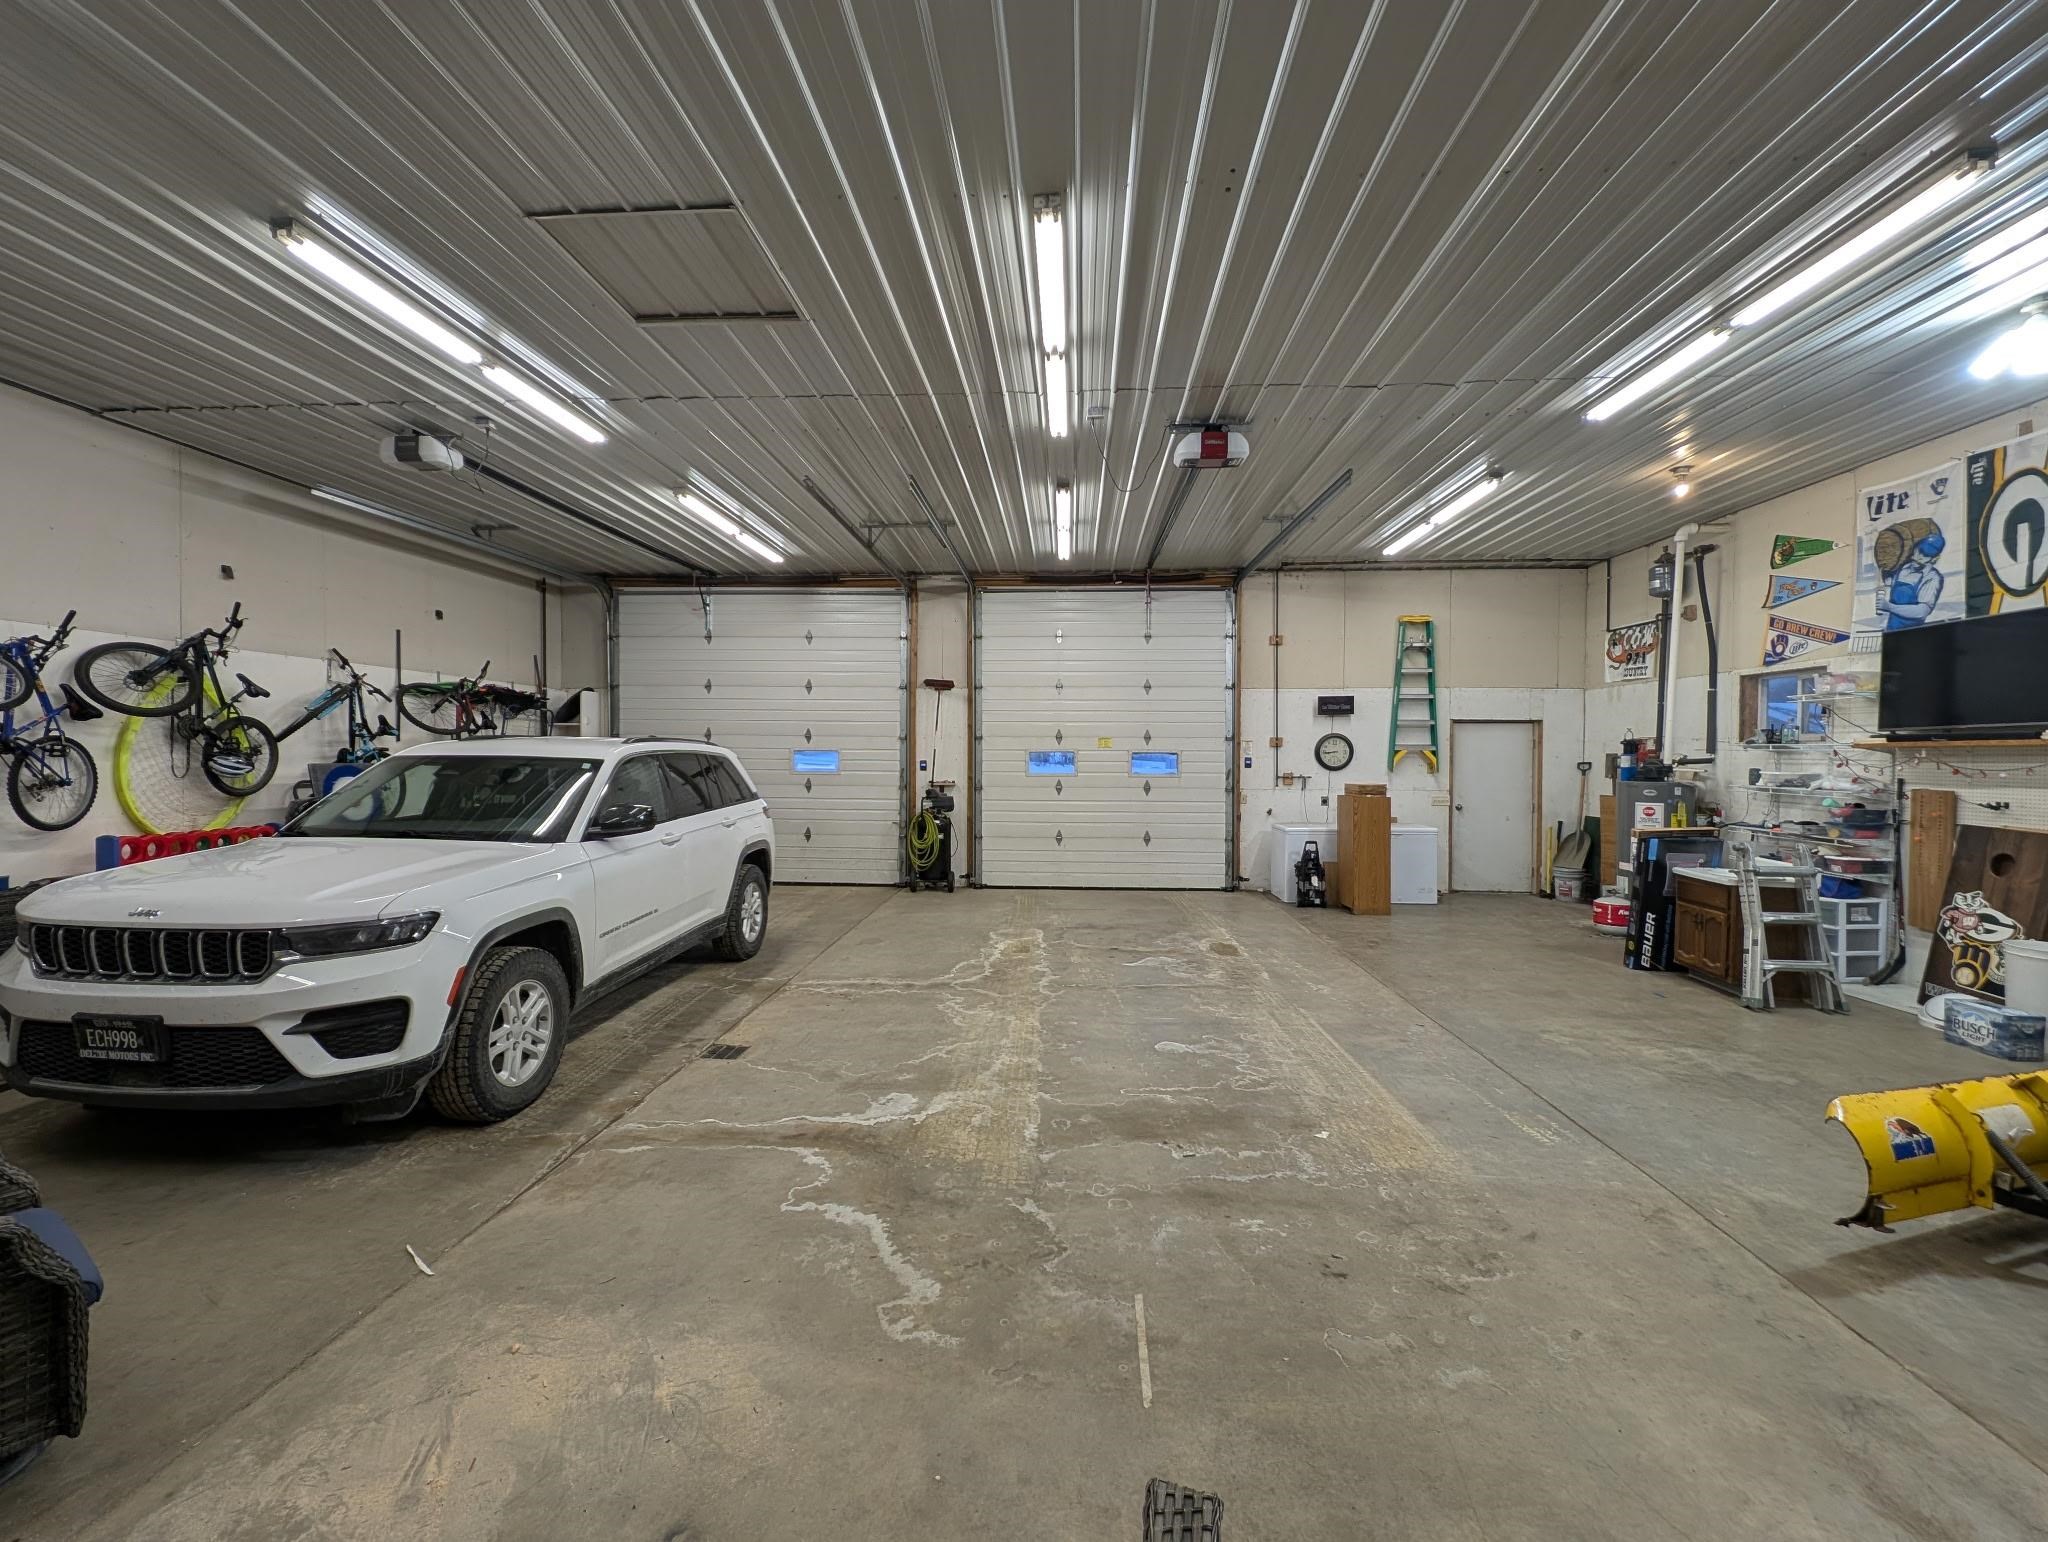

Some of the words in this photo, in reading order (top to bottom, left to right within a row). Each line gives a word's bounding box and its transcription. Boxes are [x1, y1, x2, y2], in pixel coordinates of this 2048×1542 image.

[1866, 491, 1910, 521] Lite
[1773, 618, 1784, 629] GO
[1785, 621, 1808, 636] BREW
[1809, 628, 1837, 641] CREW!
[86, 1029, 138, 1048] ECH998
[1952, 1016, 1996, 1040] BUSCH
[1962, 1032, 1986, 1044] LIGHT
